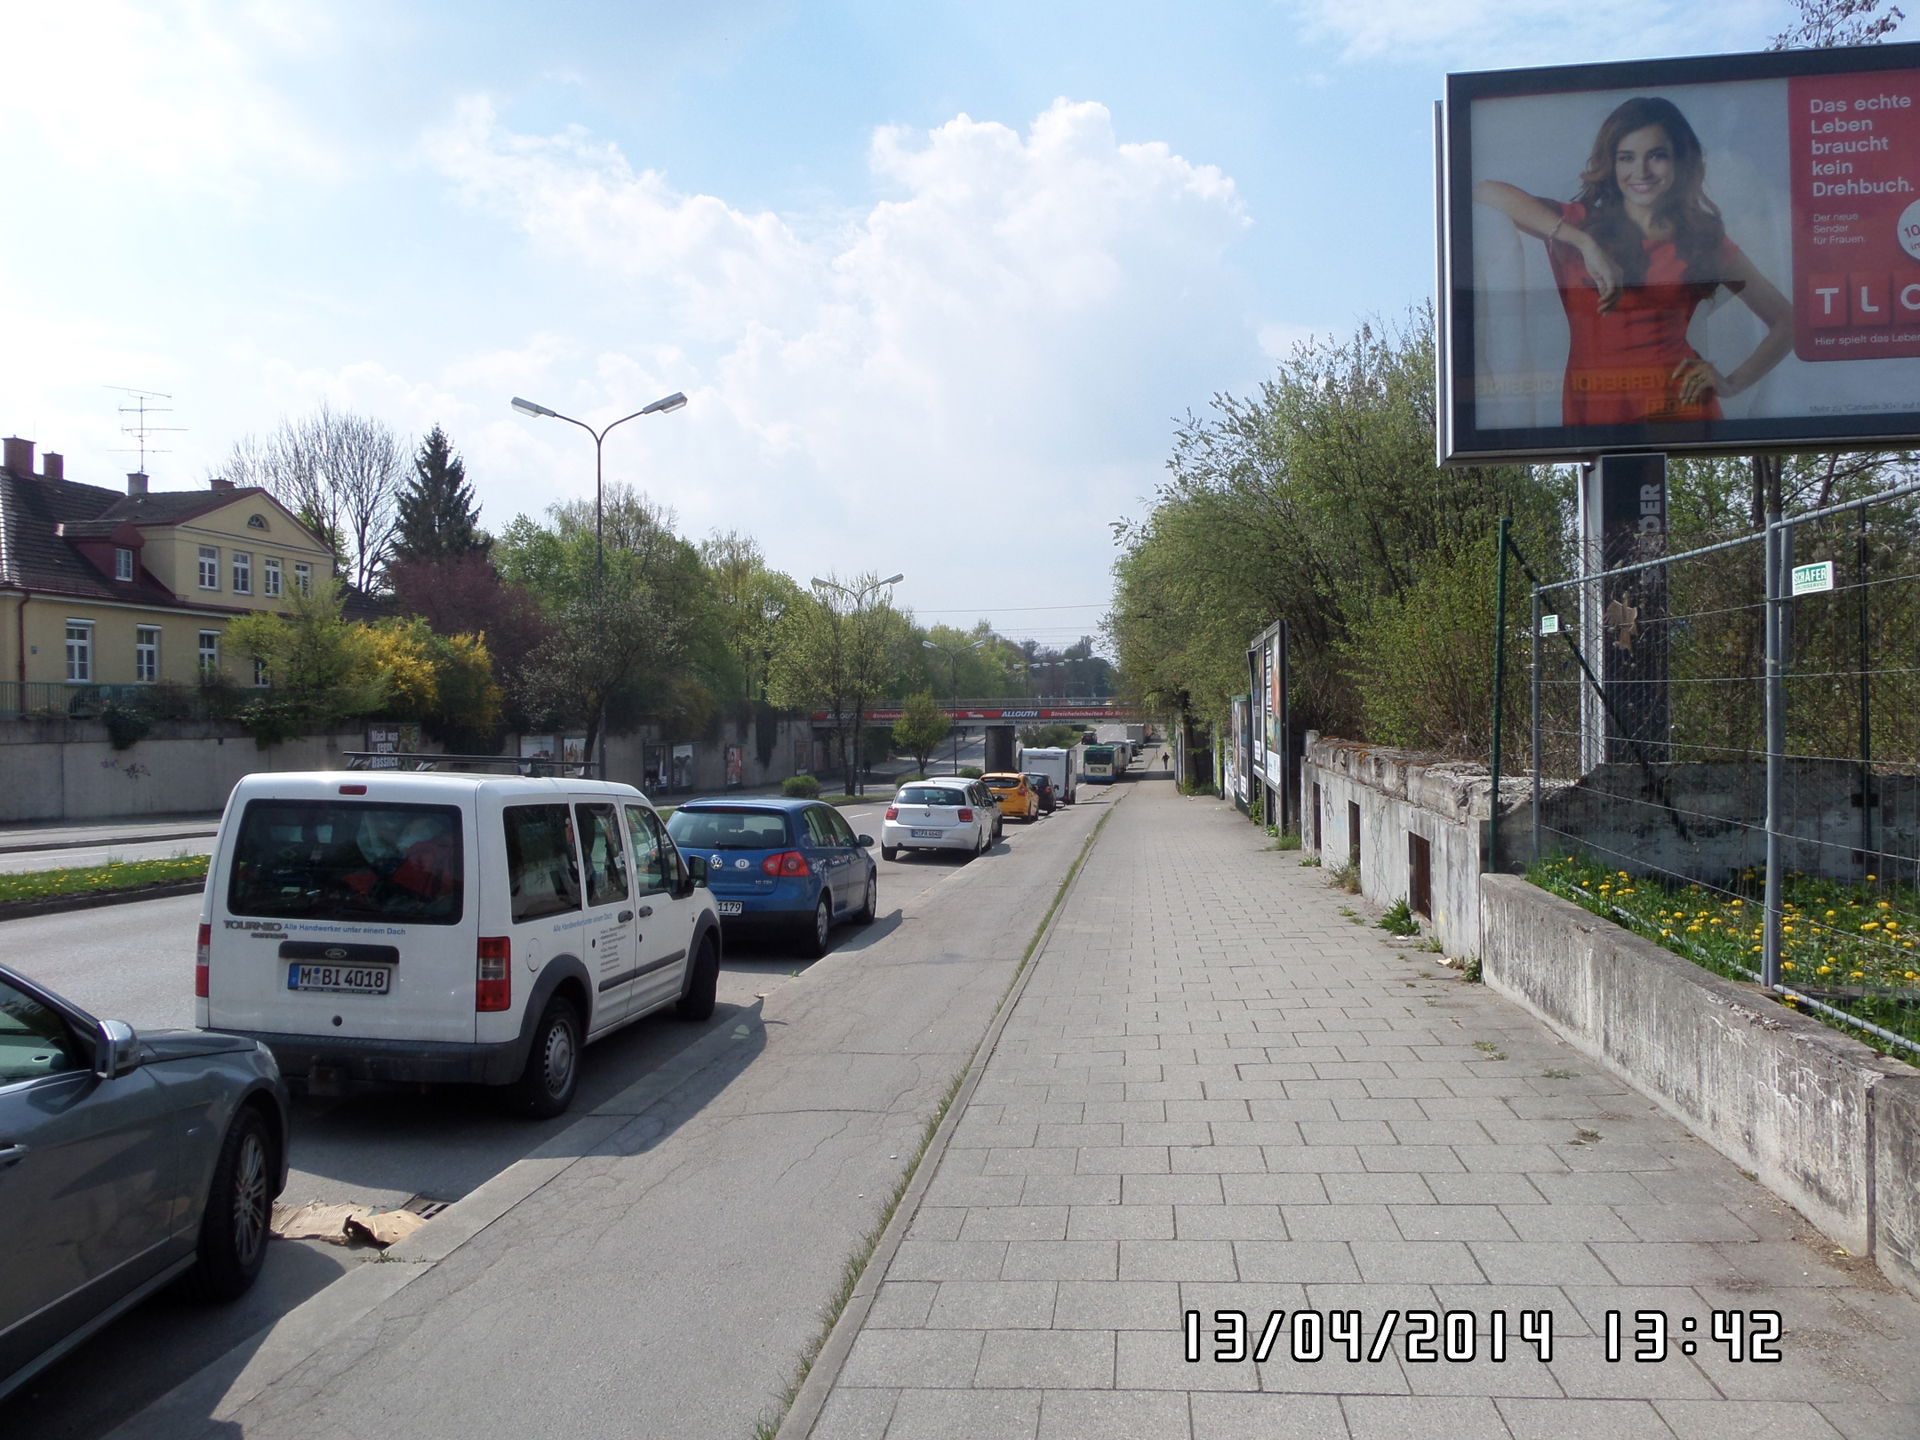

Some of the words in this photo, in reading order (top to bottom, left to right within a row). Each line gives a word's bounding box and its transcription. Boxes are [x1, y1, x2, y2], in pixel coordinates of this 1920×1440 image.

[1810, 98, 1847, 113] Das
[1854, 93, 1912, 111] echte
[1811, 117, 1873, 134] Leben
[1811, 135, 1889, 155] braucht
[1812, 160, 1853, 176] kein
[1812, 175, 1915, 197] Drehbuch.
[1813, 213, 1830, 223] Der
[1833, 212, 1859, 222] neue
[1813, 224, 1849, 234] Sender
[1813, 235, 1827, 245] für
[1815, 337, 1835, 346] Hier
[1839, 334, 1867, 346] spielt
[1870, 333, 1889, 344] das
[1001, 710, 1039, 718] ALLGUTH
[223, 920, 283, 932] TOURNEO
[284, 922, 298, 931] Alle
[299, 923, 341, 933] Handwerker
[343, 926, 362, 934] unter
[363, 927, 385, 935] einem
[387, 926, 406, 936] Dach
[344, 970, 385, 988] 4018
